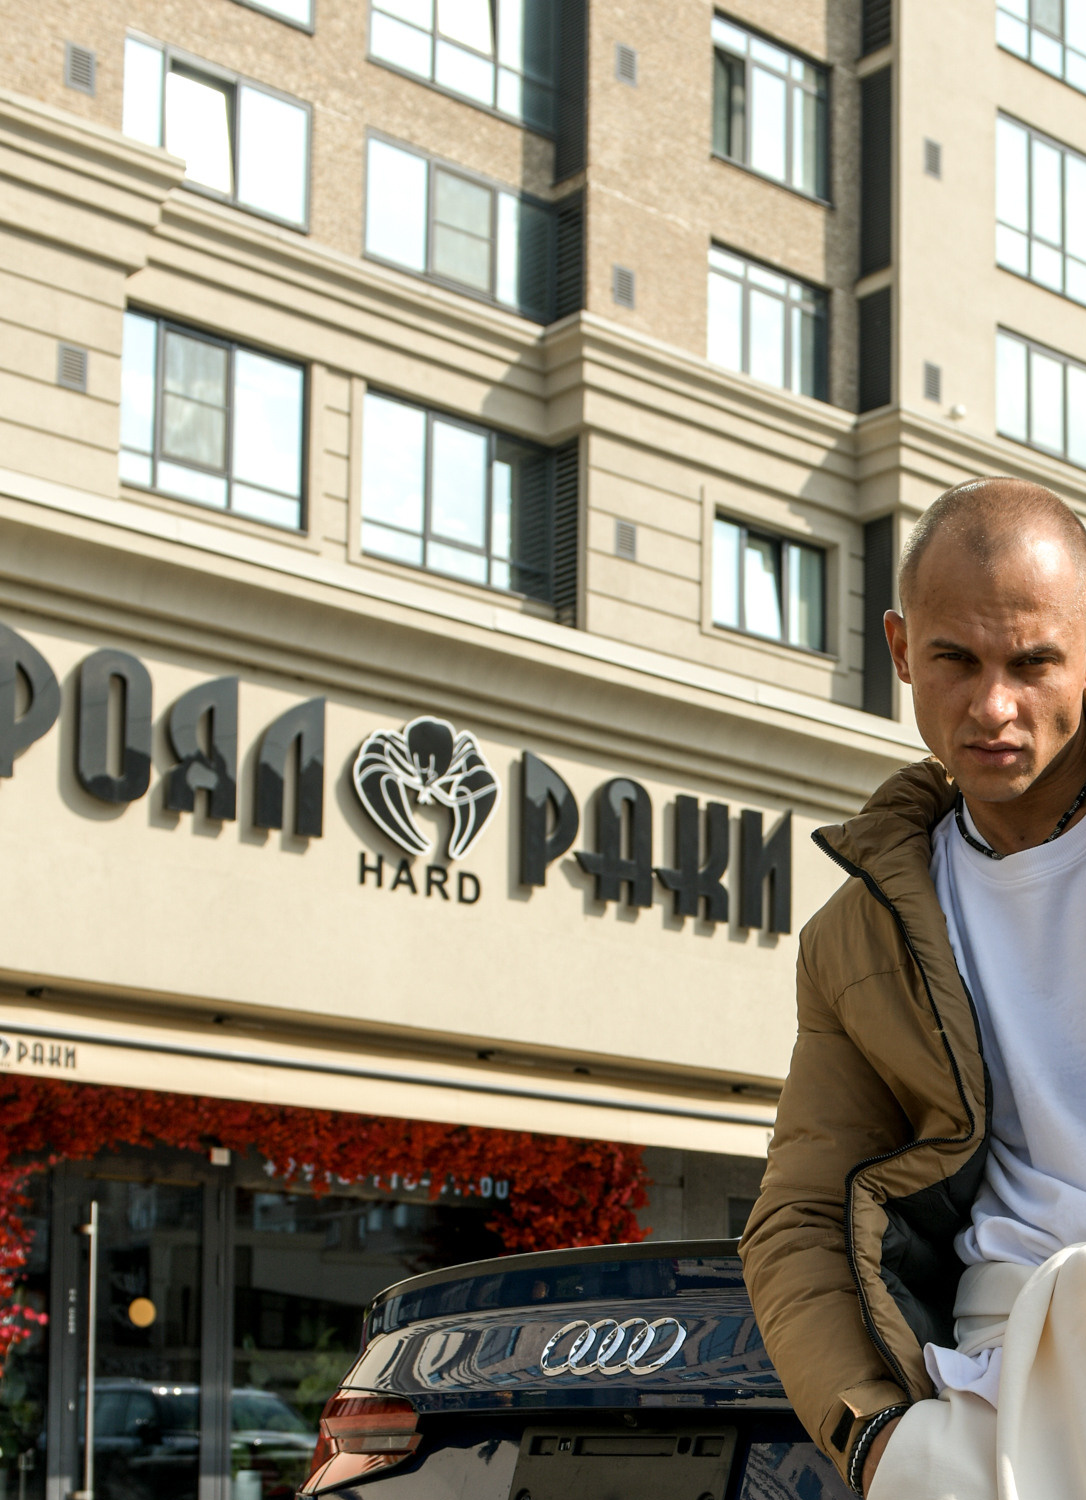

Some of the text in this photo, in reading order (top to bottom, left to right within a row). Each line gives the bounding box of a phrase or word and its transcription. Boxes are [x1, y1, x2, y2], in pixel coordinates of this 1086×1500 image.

[521, 749, 793, 935] РАКИ
[358, 851, 482, 905] HARD
[16, 1040, 77, 1069] РАКИ
